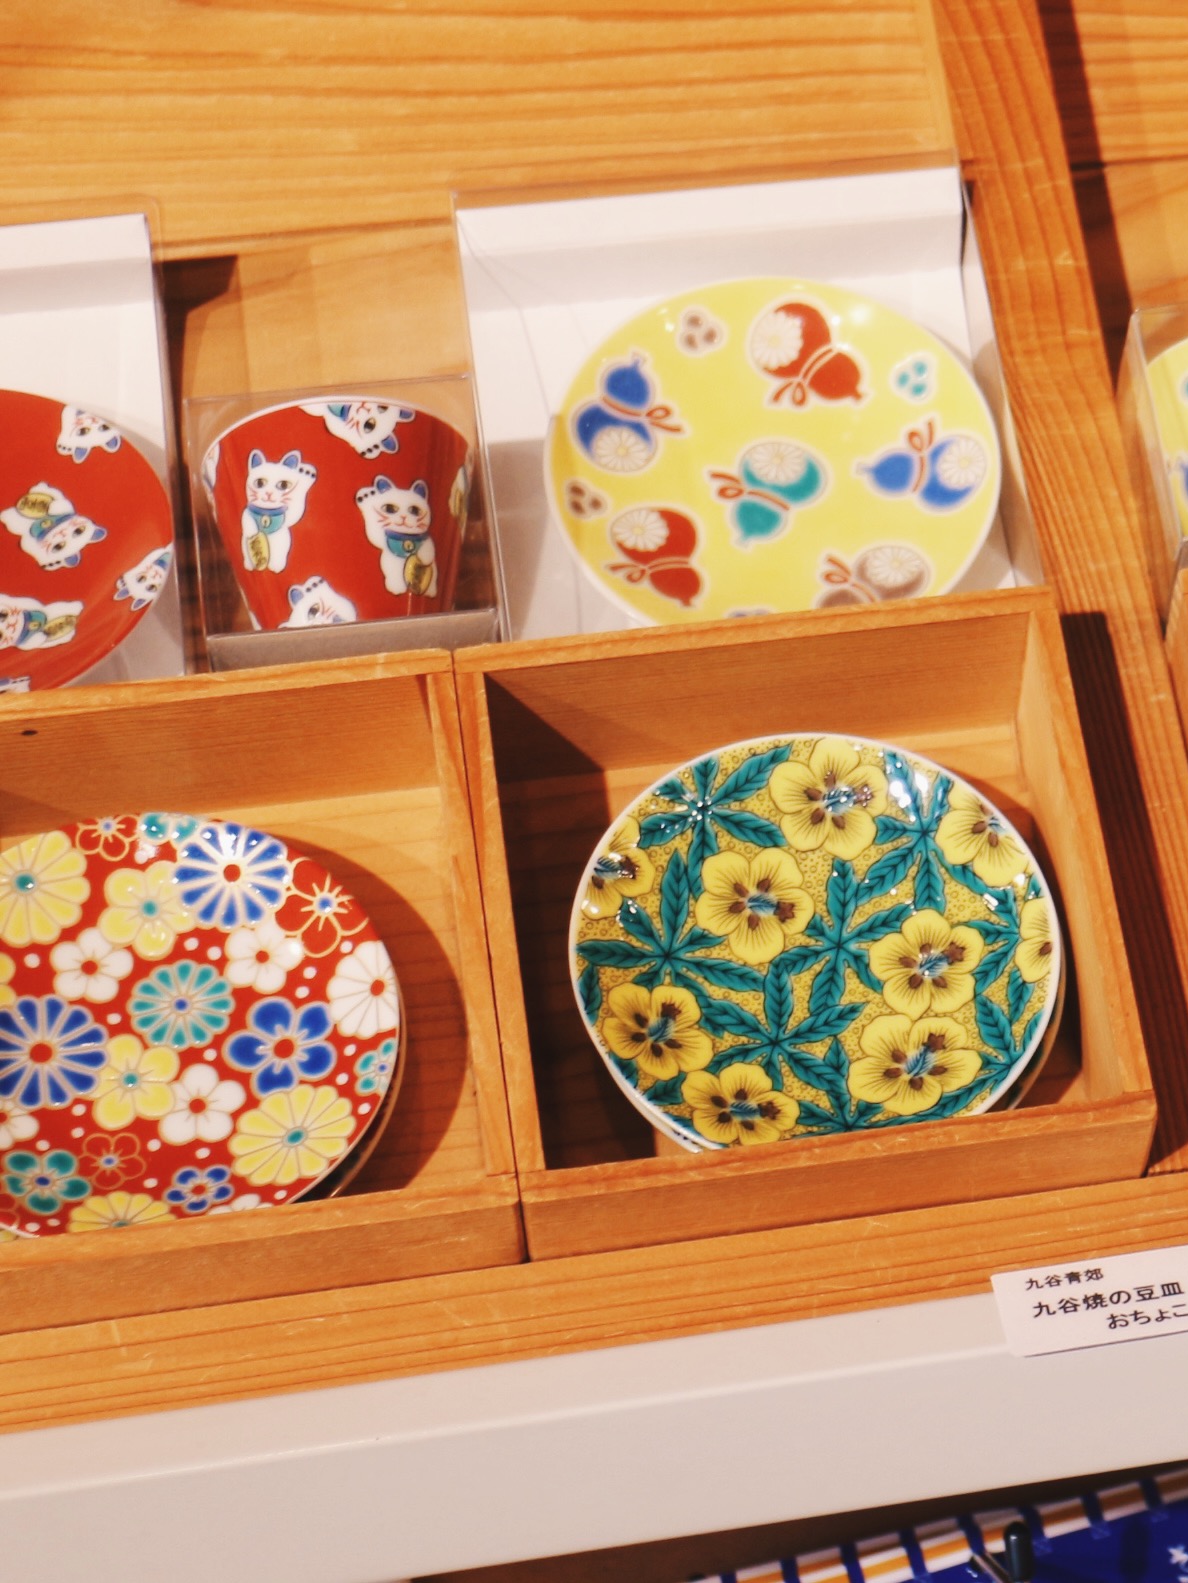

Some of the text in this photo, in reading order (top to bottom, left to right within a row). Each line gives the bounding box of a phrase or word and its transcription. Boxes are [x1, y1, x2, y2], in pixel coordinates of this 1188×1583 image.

[1025, 1268, 1104, 1290] 九谷青郊
[1033, 1281, 1184, 1318] 九谷焼の豆皿
